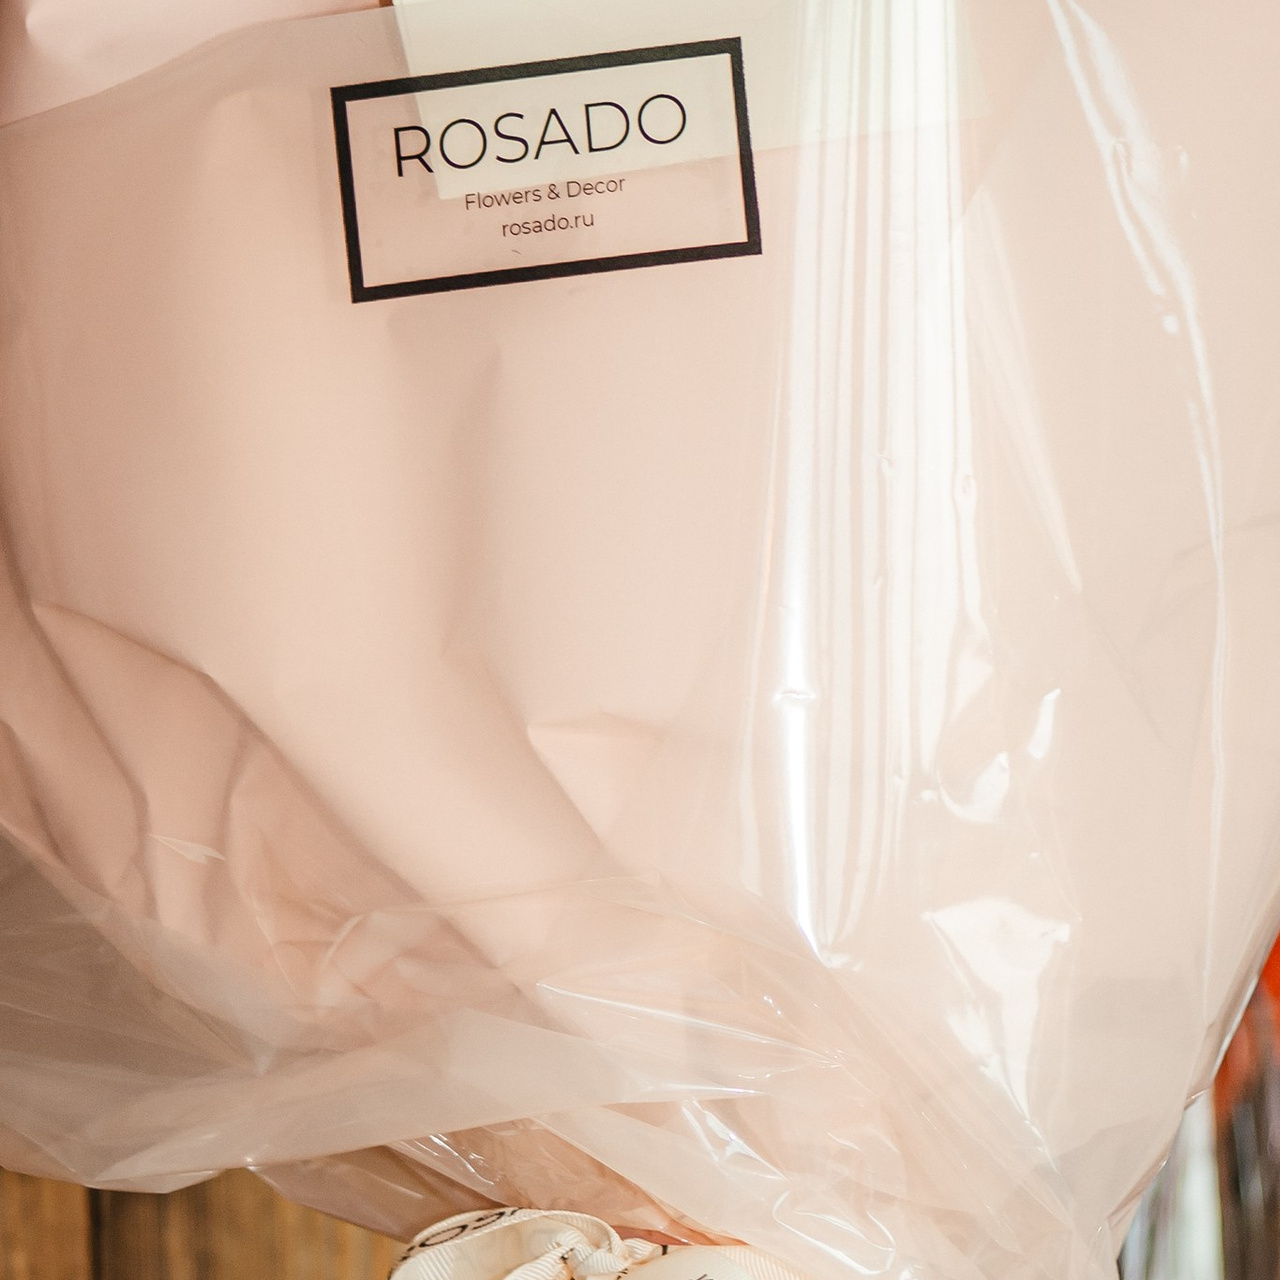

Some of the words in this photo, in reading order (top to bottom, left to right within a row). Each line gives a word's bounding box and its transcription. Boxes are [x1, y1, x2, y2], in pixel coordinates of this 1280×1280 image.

[393, 93, 687, 178] ROSADO
[464, 185, 542, 211] Flowers
[546, 183, 561, 201] &
[566, 176, 626, 198] Decor
[501, 211, 595, 238] rosado.ru
